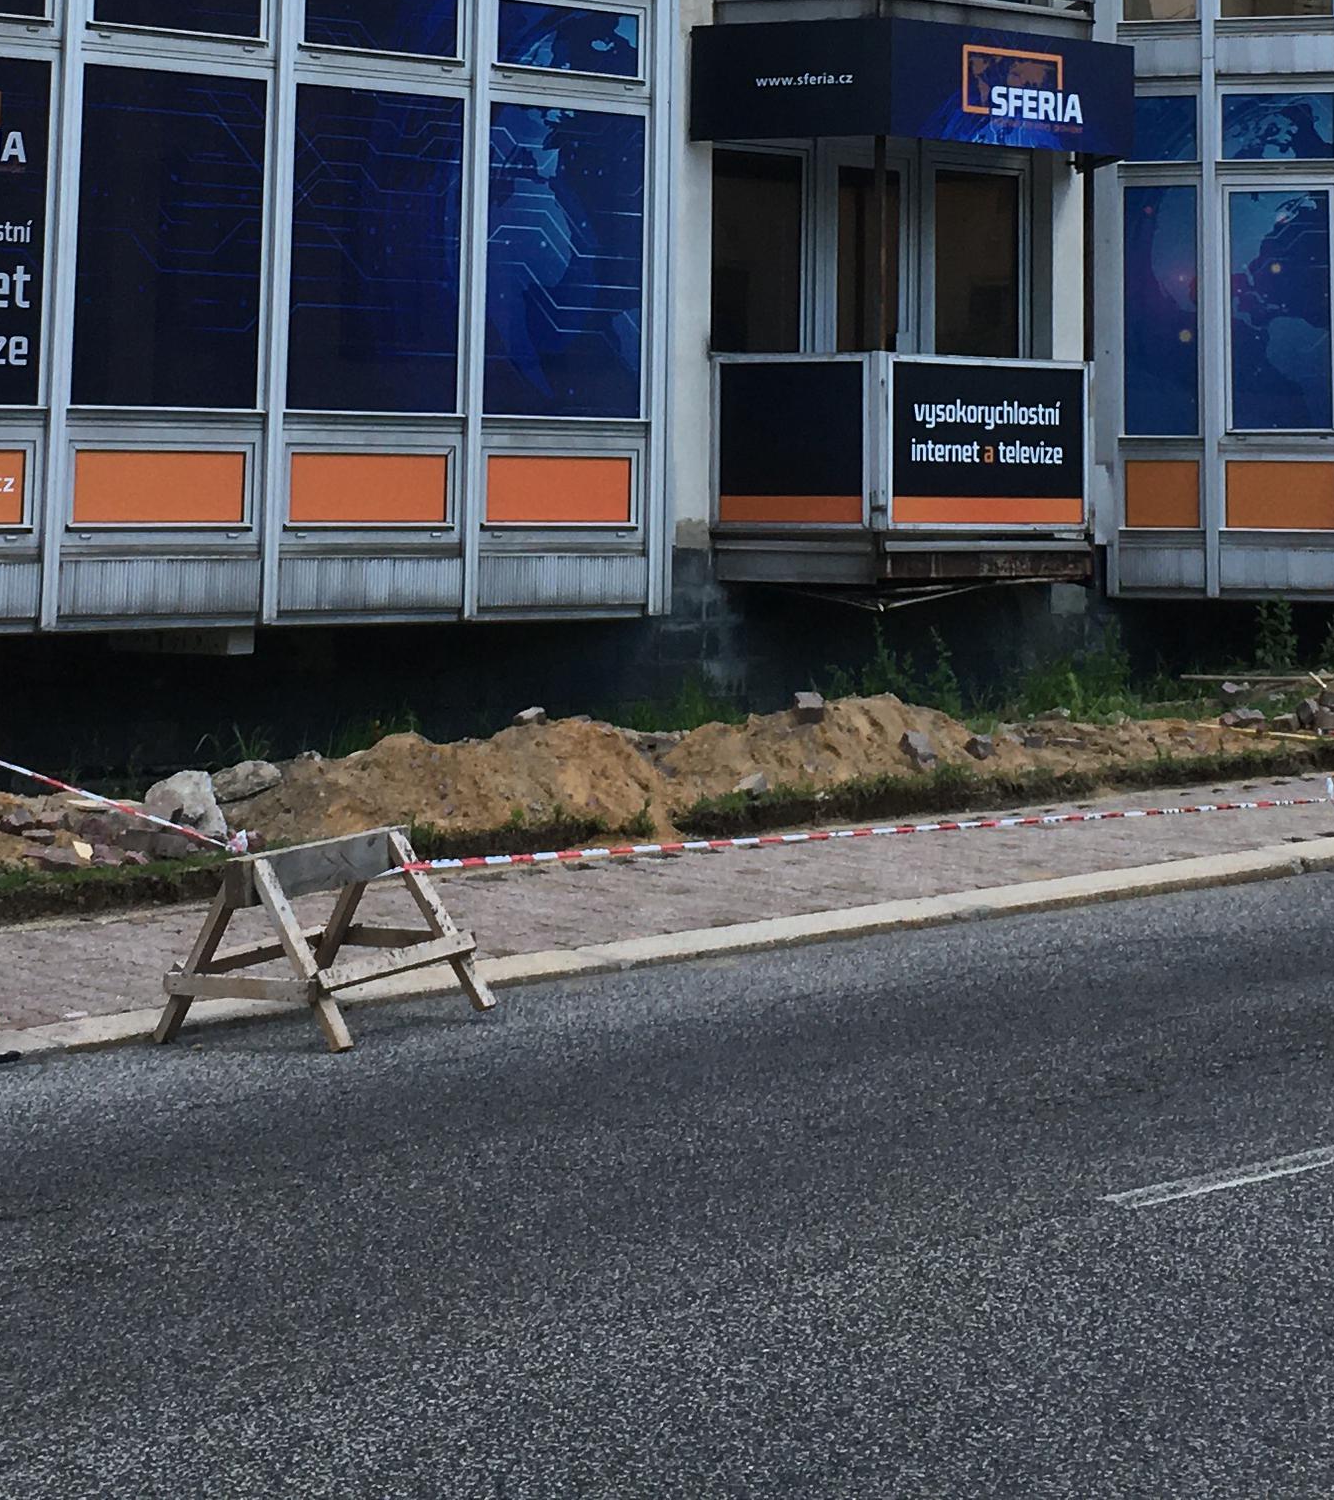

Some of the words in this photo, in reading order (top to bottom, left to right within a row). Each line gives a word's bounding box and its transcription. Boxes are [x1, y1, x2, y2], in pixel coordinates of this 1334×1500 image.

[755, 72, 854, 88] www.sferia.cz
[991, 86, 1083, 124] SFERIA
[913, 399, 1061, 430] vysokorychlostní
[911, 436, 980, 463] internet
[984, 446, 994, 463] a
[998, 441, 1063, 465] televize
